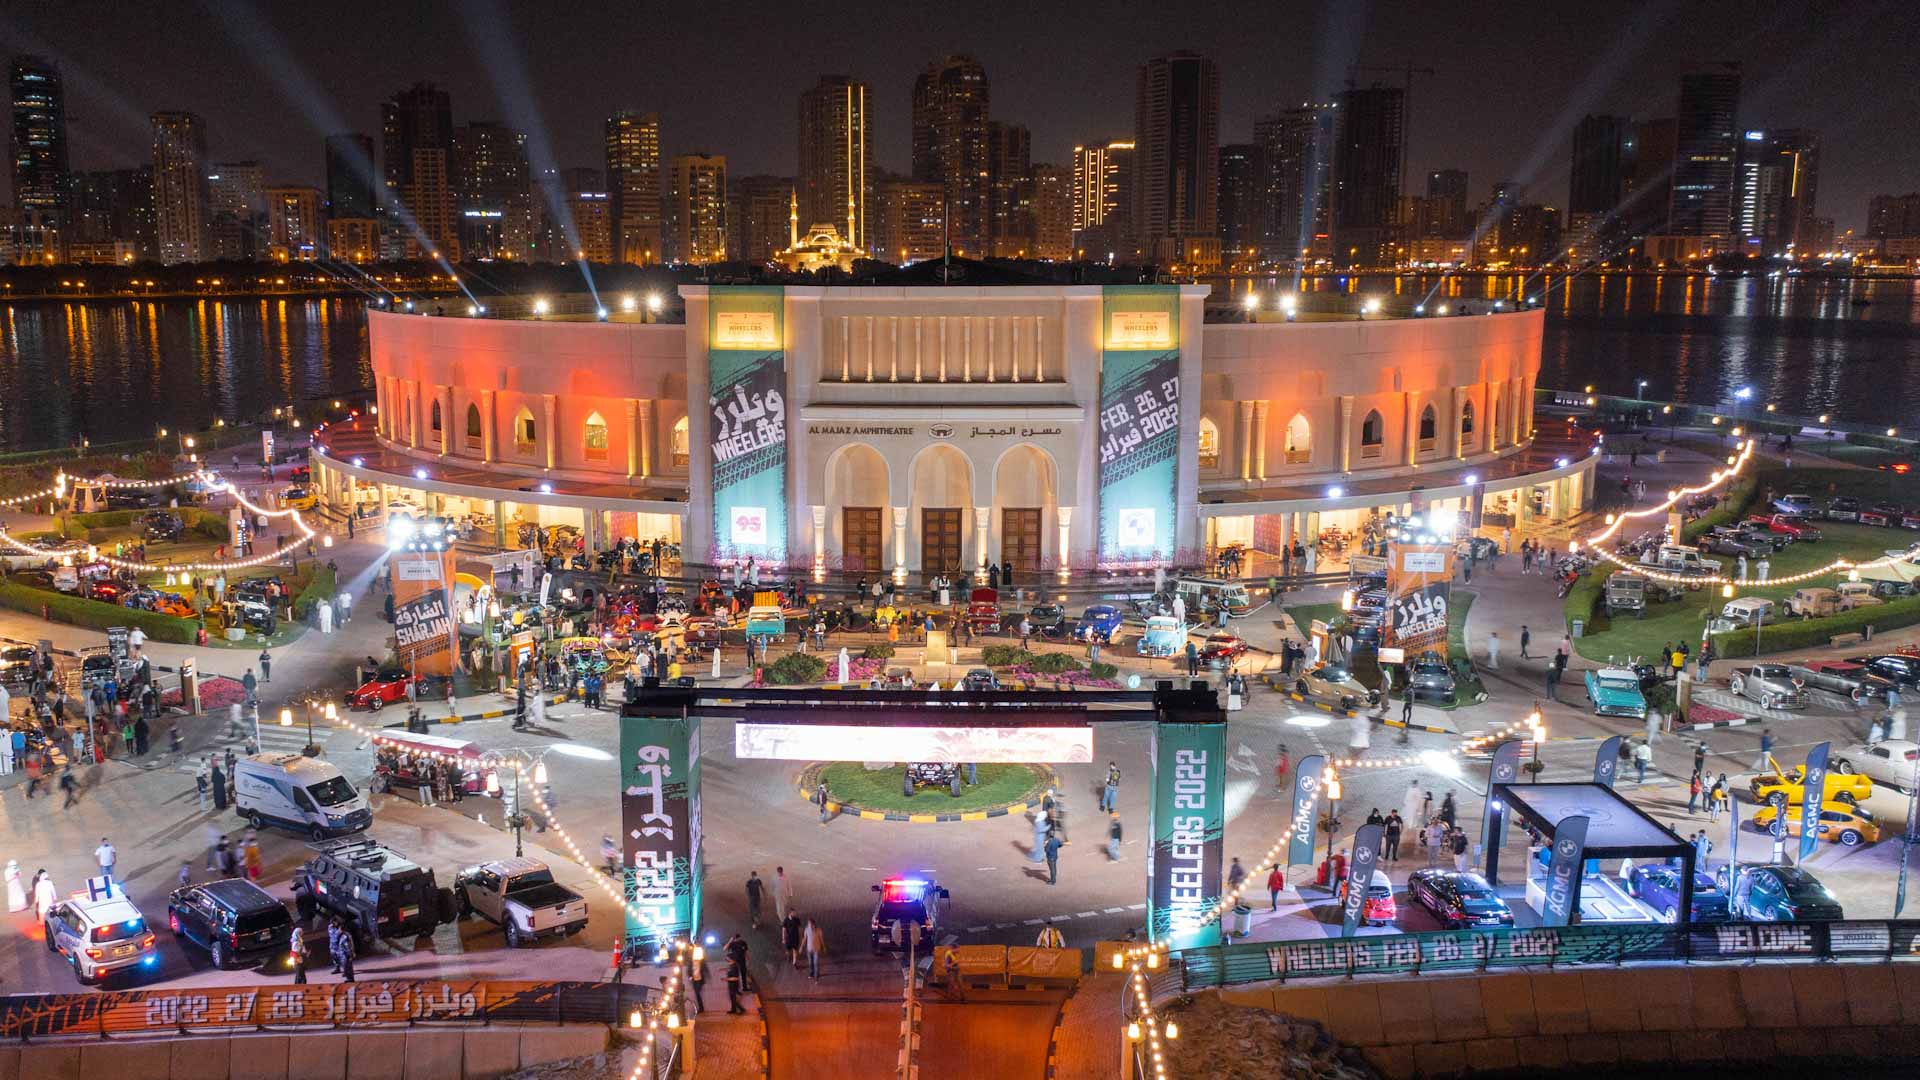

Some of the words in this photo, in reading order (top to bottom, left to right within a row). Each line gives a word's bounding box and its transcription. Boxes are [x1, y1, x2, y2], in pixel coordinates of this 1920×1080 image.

[1101, 403, 1135, 432] FEB.
[1134, 390, 1162, 416] 26.
[1161, 376, 1179, 402] 27
[711, 420, 785, 462] WHEELERS
[969, 426, 1016, 438] المجاز
[1021, 428, 1062, 438] مسرح
[1100, 422, 1142, 464] فبراير
[1140, 403, 1178, 439] 2022
[396, 600, 445, 626] الشارقة
[1395, 615, 1447, 640] WHEELERS
[1396, 592, 1447, 627] ويلرز
[396, 616, 450, 646] SHARJAH
[1174, 749, 1207, 809] 2022
[1296, 798, 1314, 845] AGMC
[1807, 791, 1822, 839] AGMC
[635, 850, 676, 926] 2022
[1346, 871, 1367, 920] AGMC
[1549, 864, 1572, 917] AGMC
[1715, 925, 1813, 953] WELCOME
[146, 995, 209, 1026] 2022
[323, 982, 393, 1020] فبراير
